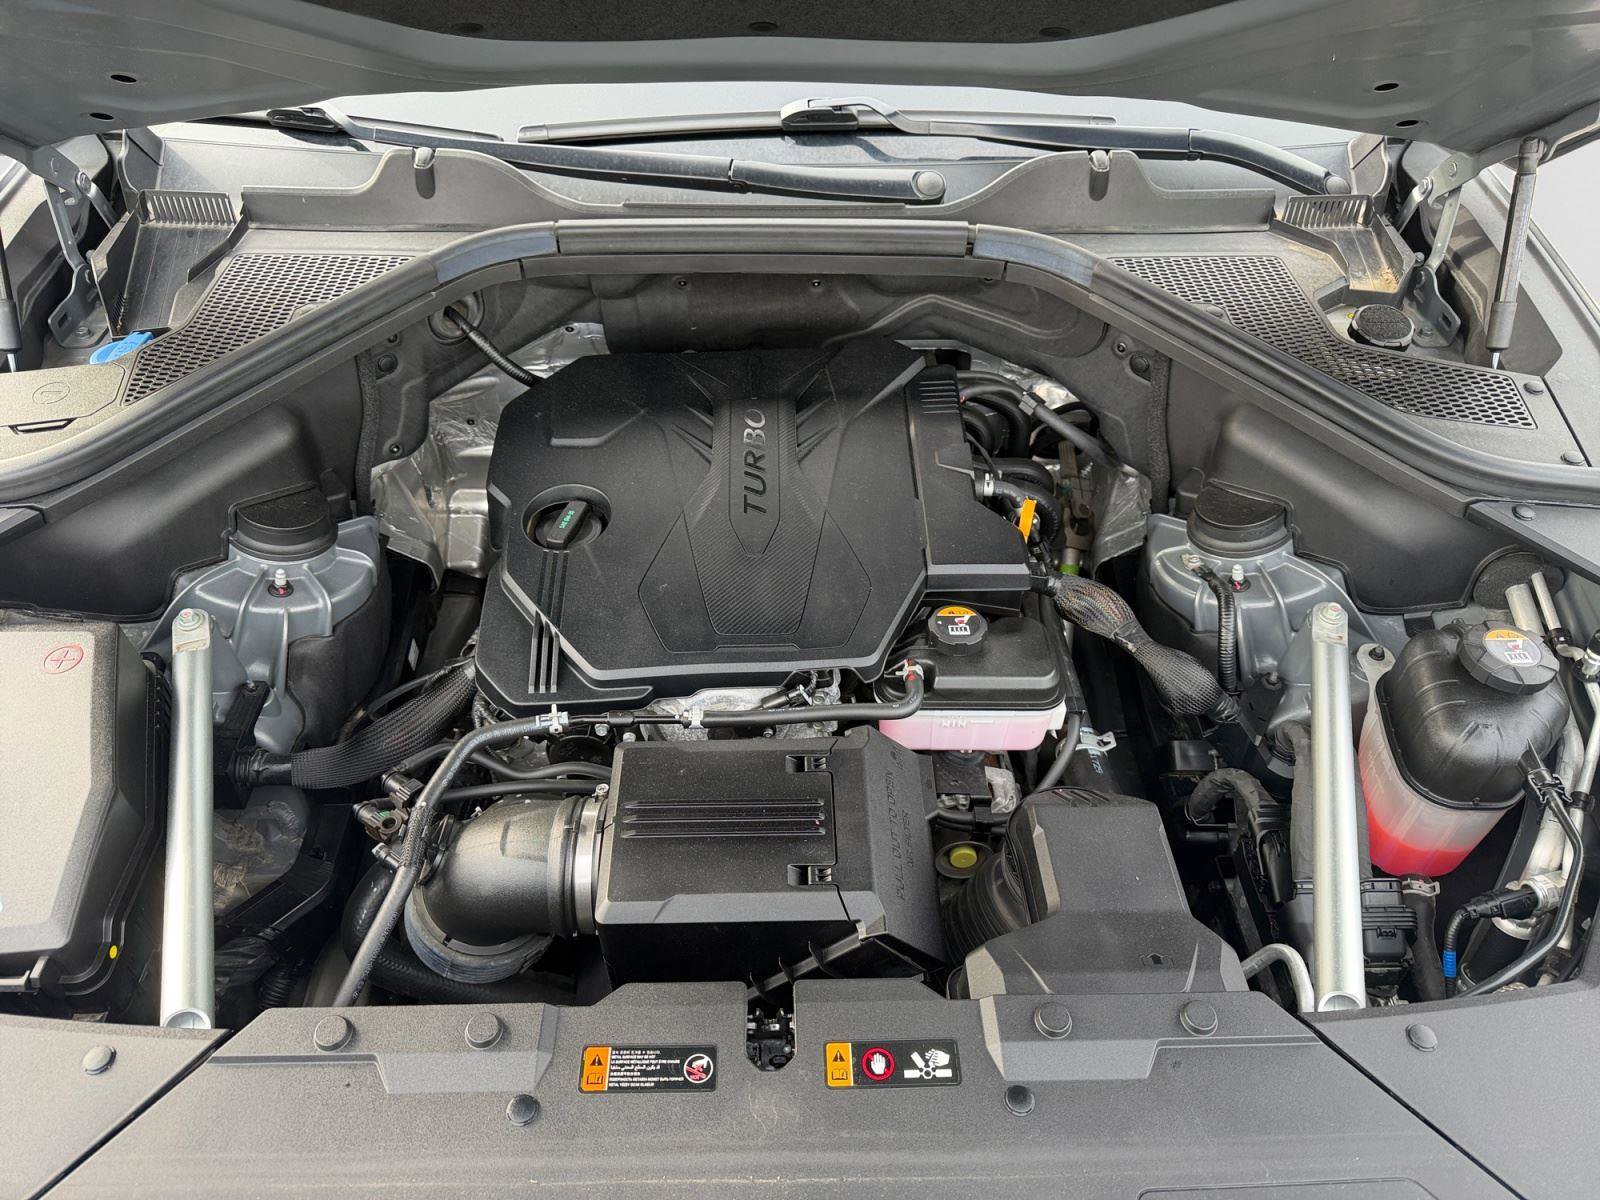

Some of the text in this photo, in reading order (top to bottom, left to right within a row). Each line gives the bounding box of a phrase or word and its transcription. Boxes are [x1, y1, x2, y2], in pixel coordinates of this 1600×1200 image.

[744, 408, 767, 514] TURBO
[885, 770, 897, 806] OPEN
[888, 808, 898, 826] TO
[891, 830, 902, 859] OUT
[896, 863, 906, 900] PULL
